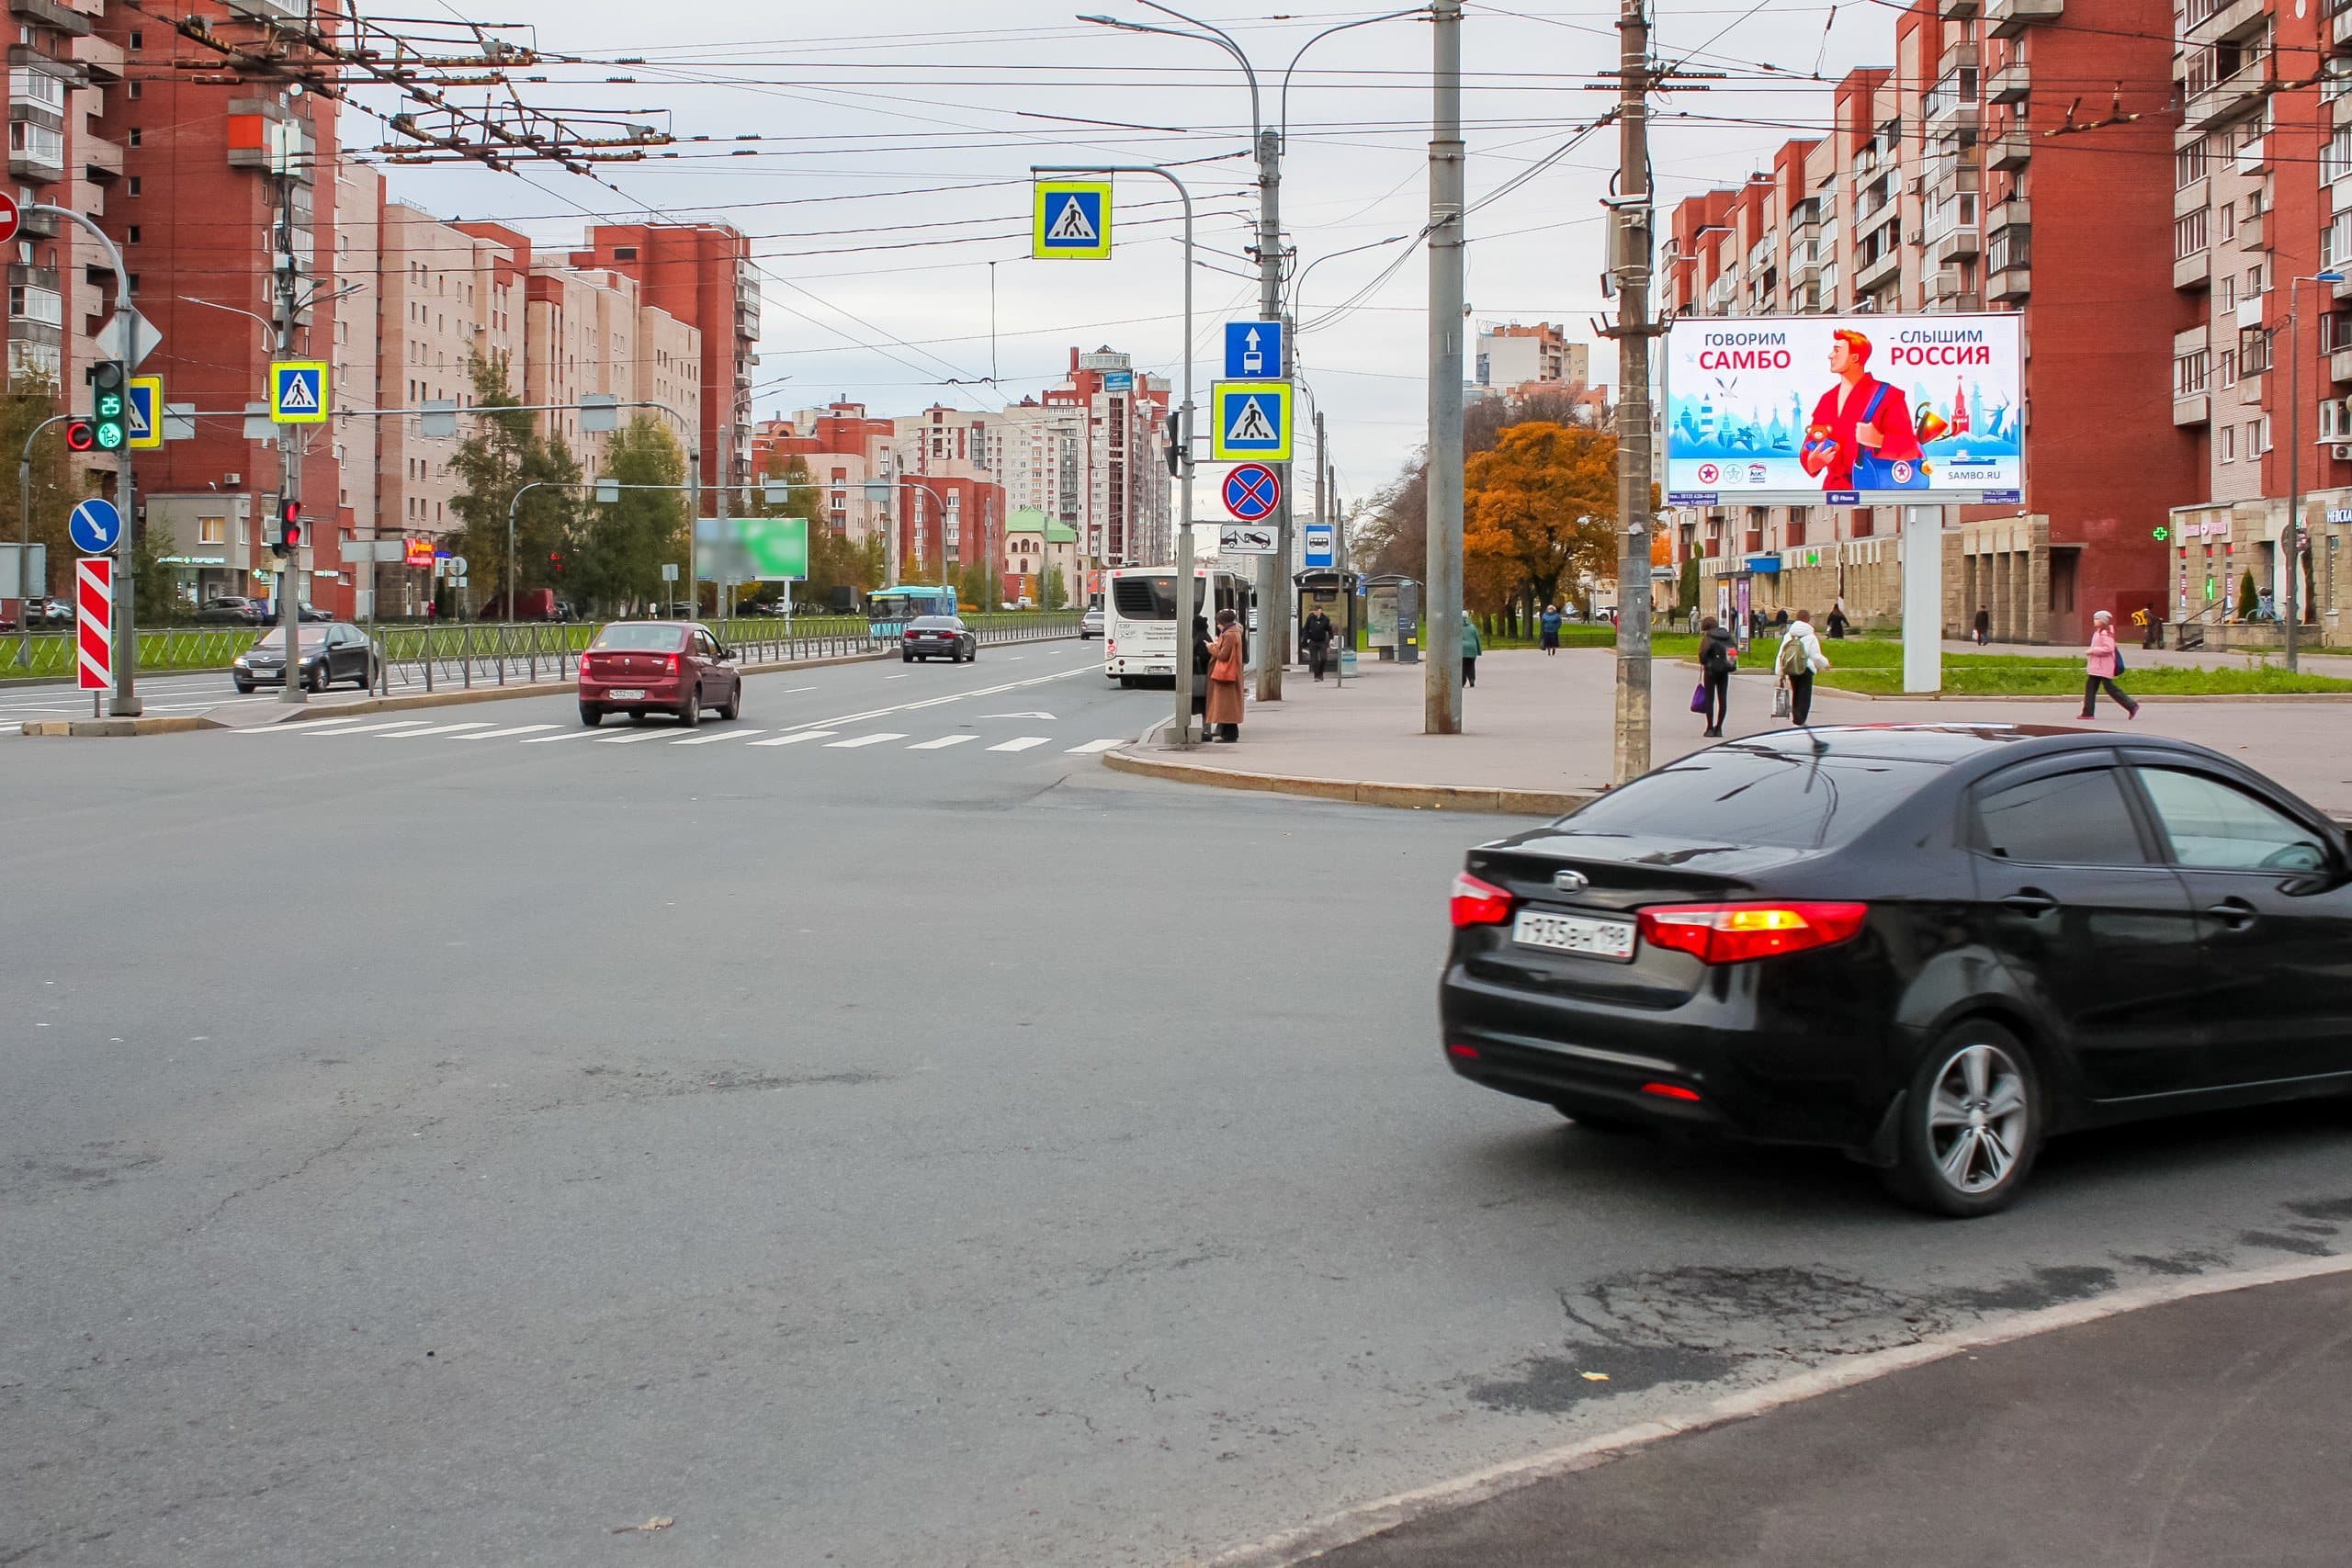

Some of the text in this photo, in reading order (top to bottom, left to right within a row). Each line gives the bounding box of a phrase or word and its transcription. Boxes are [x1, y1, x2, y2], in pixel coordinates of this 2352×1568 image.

[1704, 333, 1786, 346] ГОВОРИМ
[1900, 330, 1983, 344] СЛЫШИМ
[1699, 349, 1792, 369] САМБО
[1890, 345, 1990, 366] РОССИЯ
[101, 398, 119, 414] 25
[1947, 470, 2001, 480] SAMBO.RU
